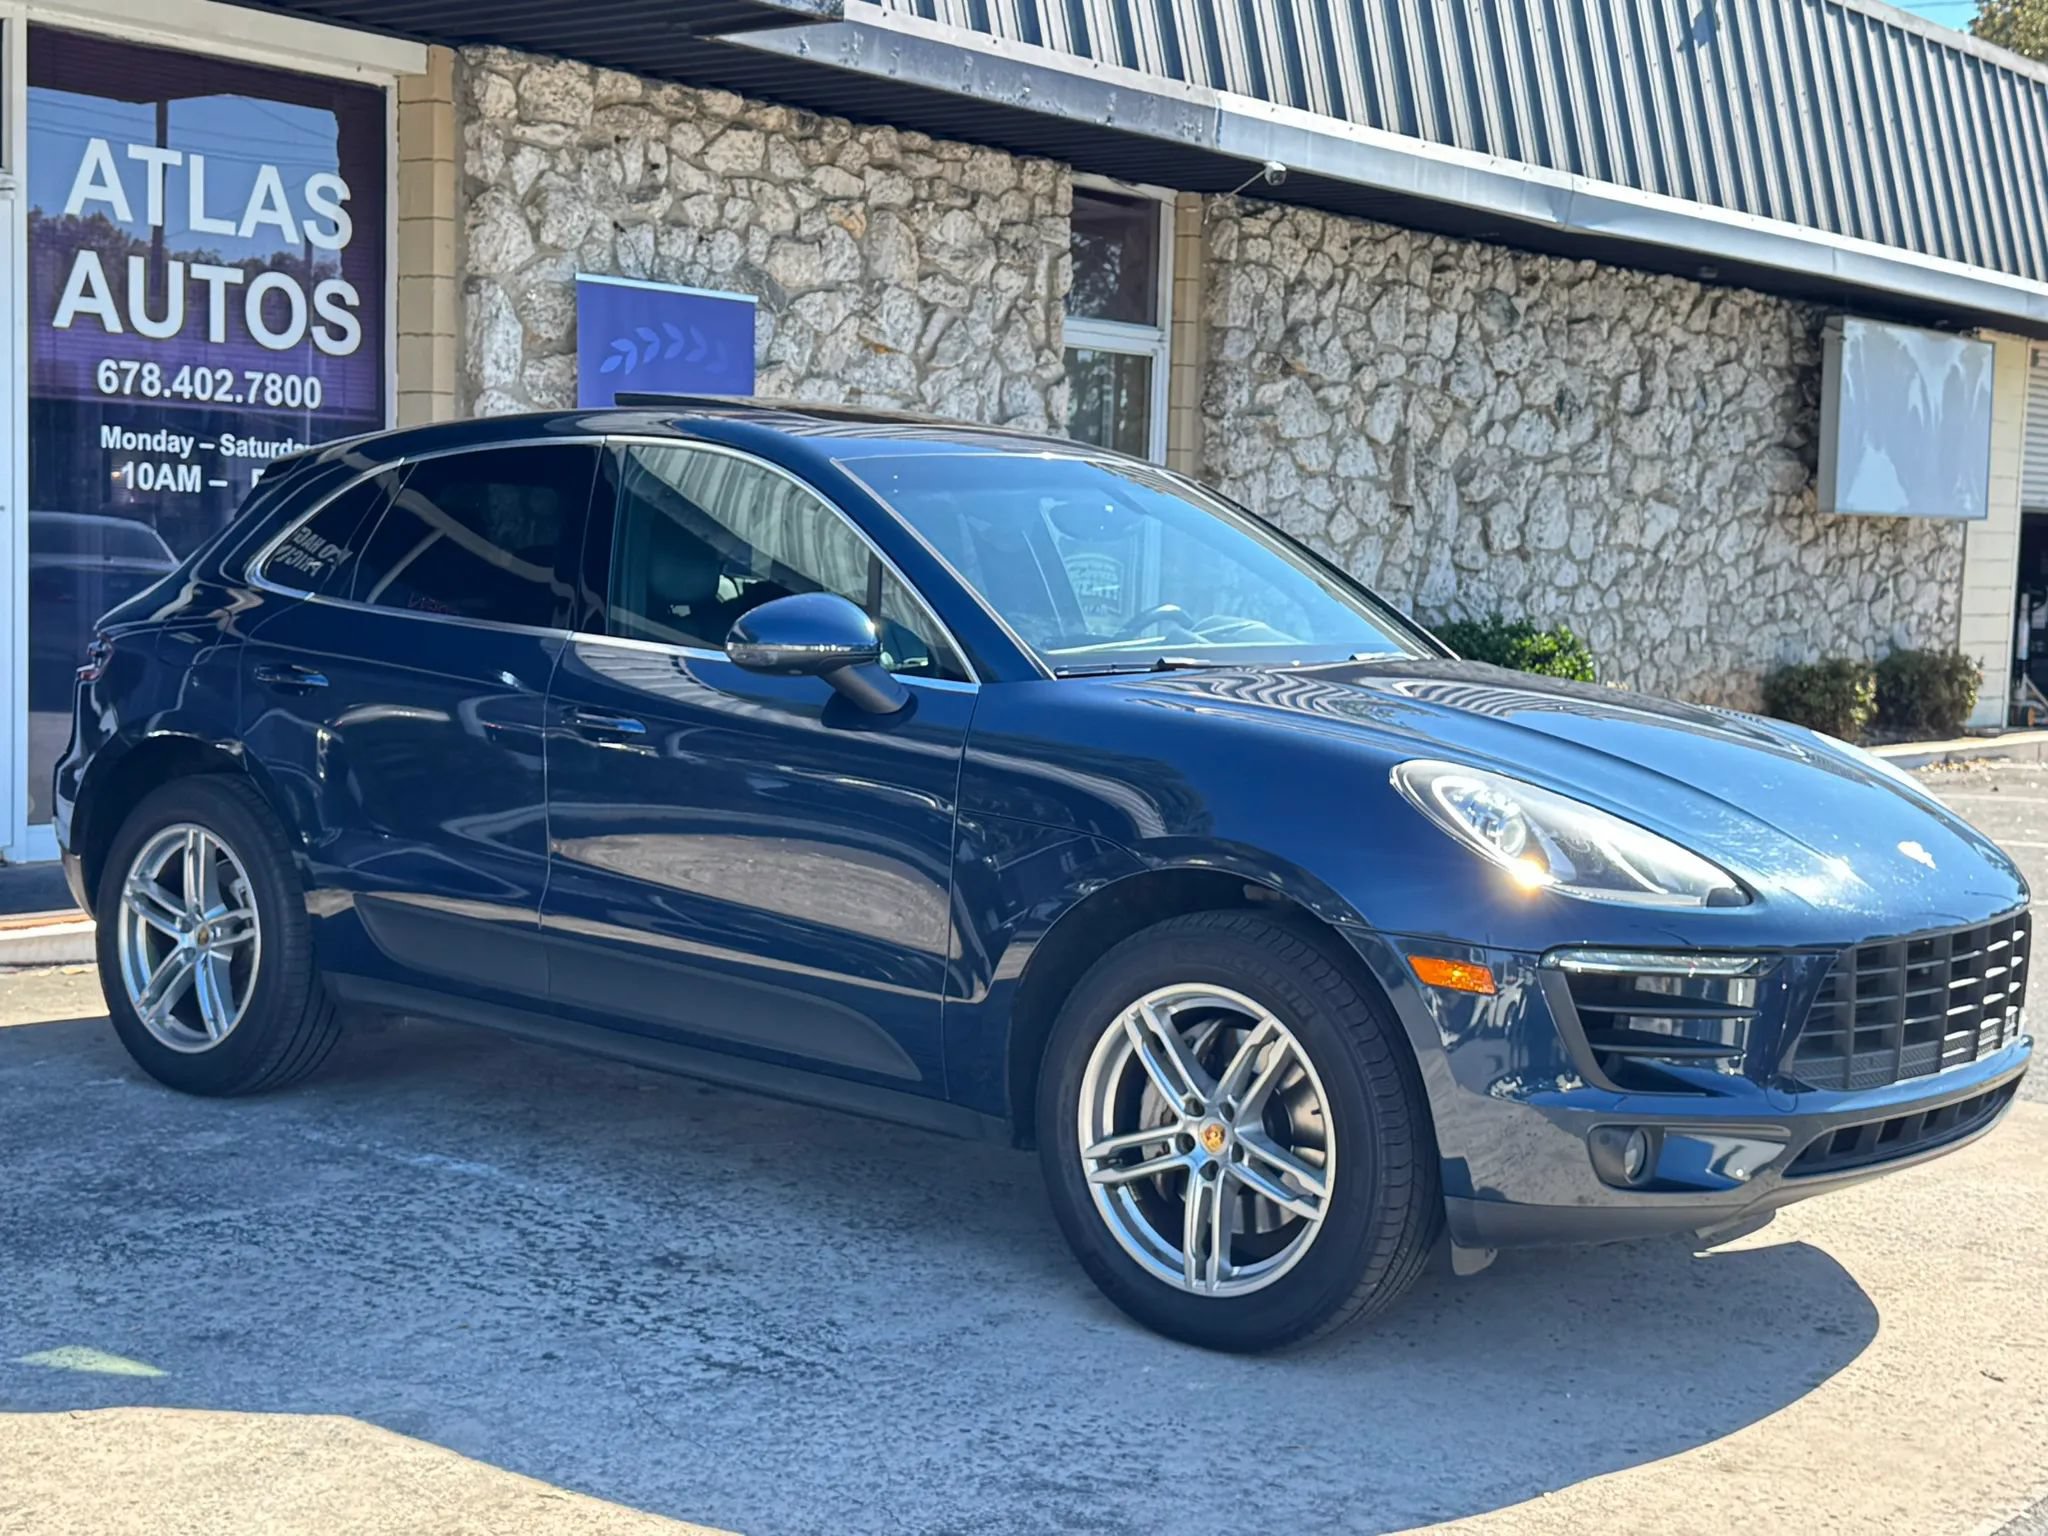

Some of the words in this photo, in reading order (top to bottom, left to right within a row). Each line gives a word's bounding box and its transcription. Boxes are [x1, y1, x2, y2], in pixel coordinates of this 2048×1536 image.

[64, 137, 353, 250] ATLAS
[52, 250, 361, 355] AUTOS
[98, 358, 322, 409] 678.402.7800
[100, 425, 194, 459] Monday
[219, 433, 310, 459] Saturd
[121, 460, 202, 493] 10AM
